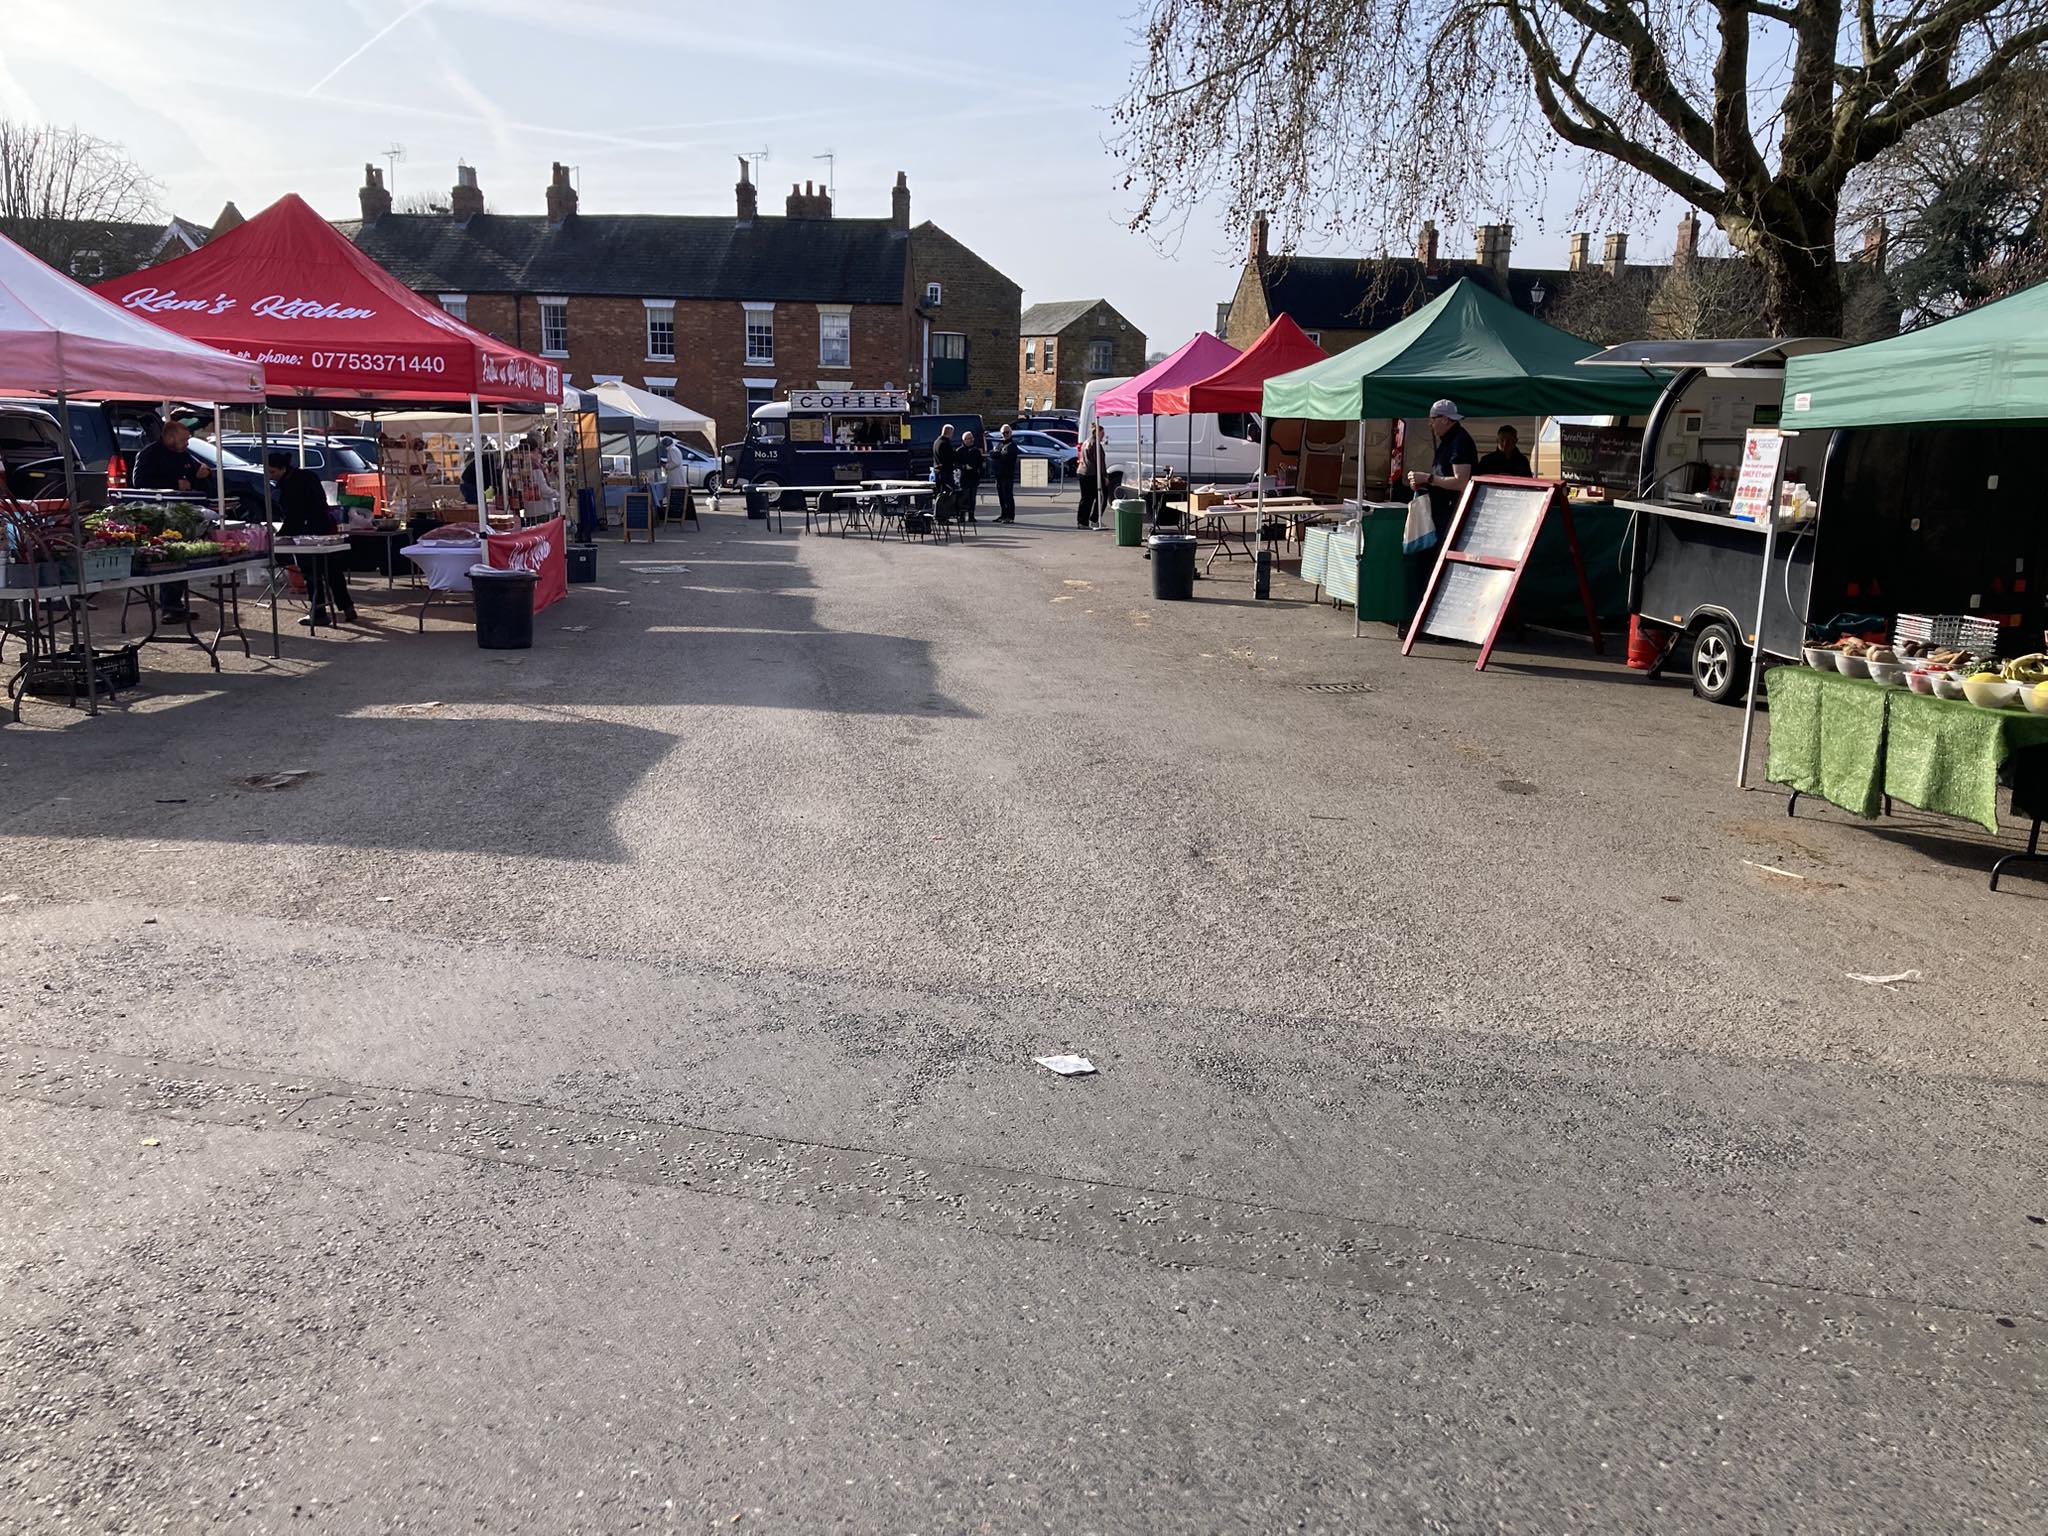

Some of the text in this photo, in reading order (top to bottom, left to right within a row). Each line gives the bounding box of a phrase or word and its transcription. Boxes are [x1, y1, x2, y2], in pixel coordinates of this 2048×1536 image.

[122, 287, 376, 320] Kam's Kitchen
[256, 349, 303, 366] phone:
[311, 351, 445, 373] 07753371440
[800, 396, 898, 408] COFFEE
[754, 450, 778, 458] No.13
